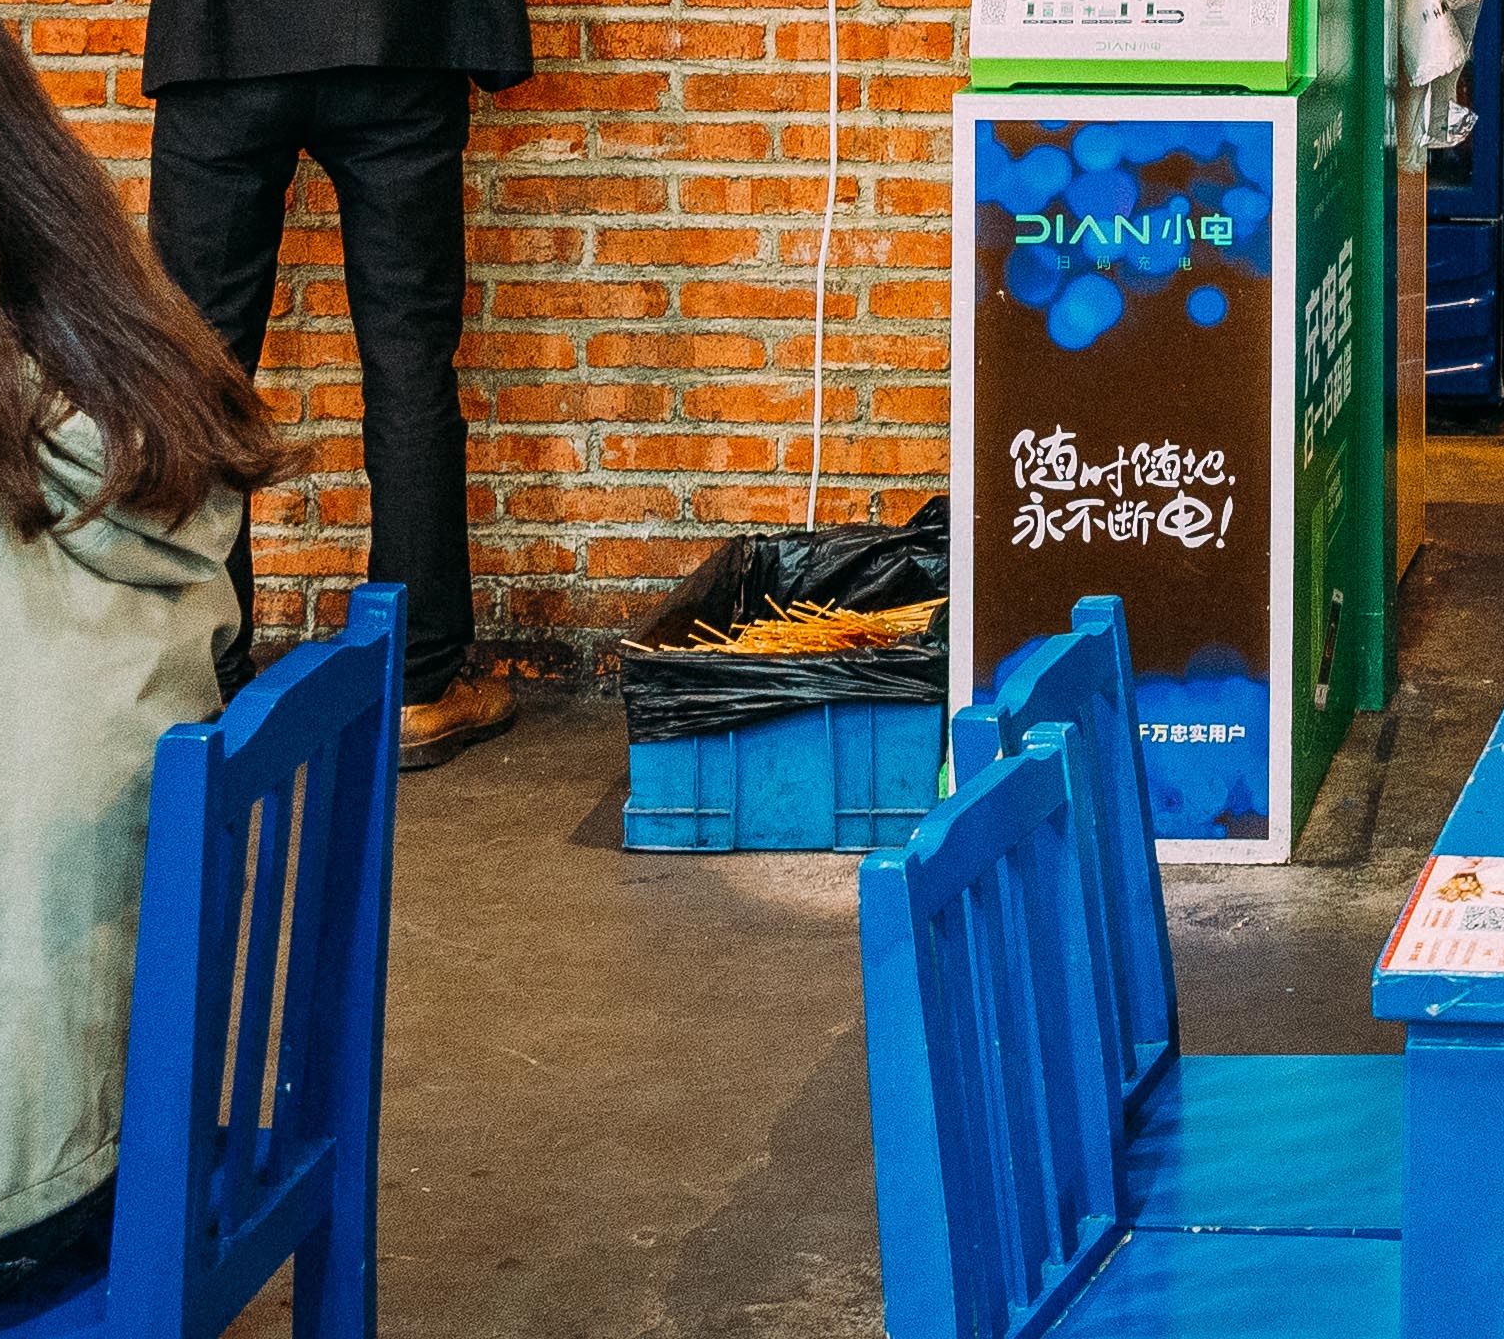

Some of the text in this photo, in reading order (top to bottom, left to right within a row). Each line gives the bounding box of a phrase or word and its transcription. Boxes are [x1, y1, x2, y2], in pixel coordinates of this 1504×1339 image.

[1015, 211, 1233, 246] DIAN 小电
[1011, 493, 1233, 552] 永不断电!
